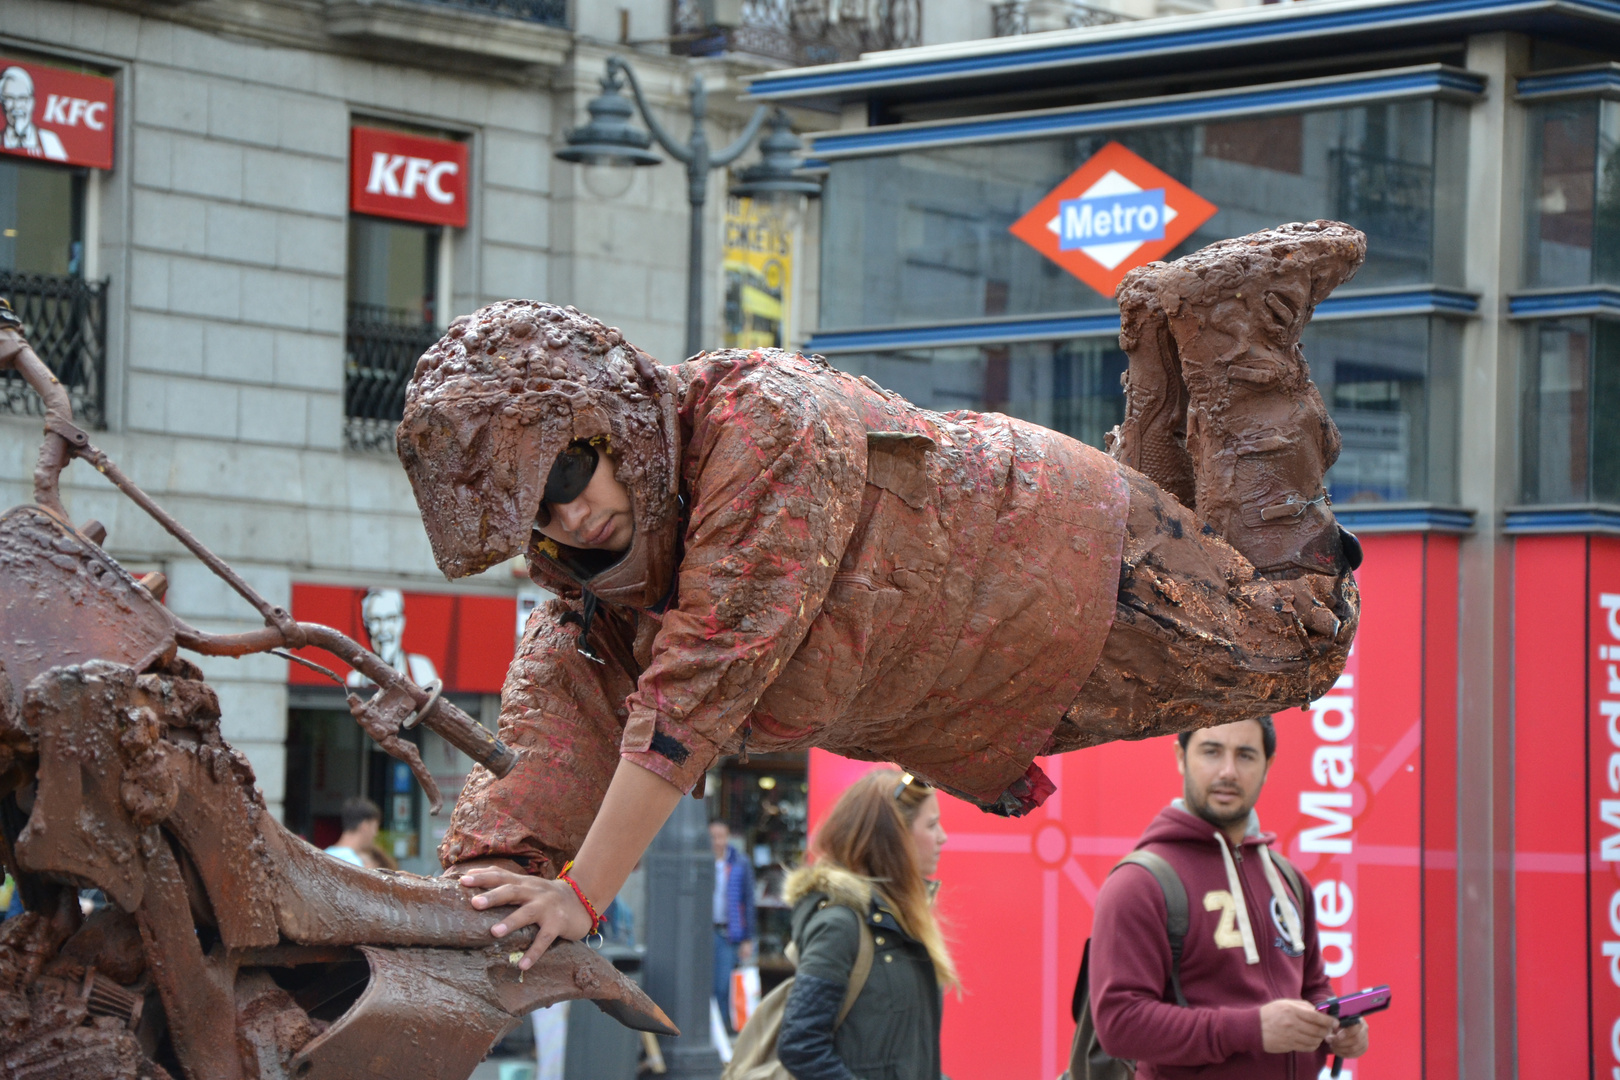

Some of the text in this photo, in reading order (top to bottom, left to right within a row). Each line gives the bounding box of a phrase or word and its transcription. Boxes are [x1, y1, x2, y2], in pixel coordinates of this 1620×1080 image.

[42, 94, 107, 131] KFC
[365, 152, 459, 205] KFC
[1065, 203, 1159, 240] Metro
[1299, 643, 1355, 855] Mad
